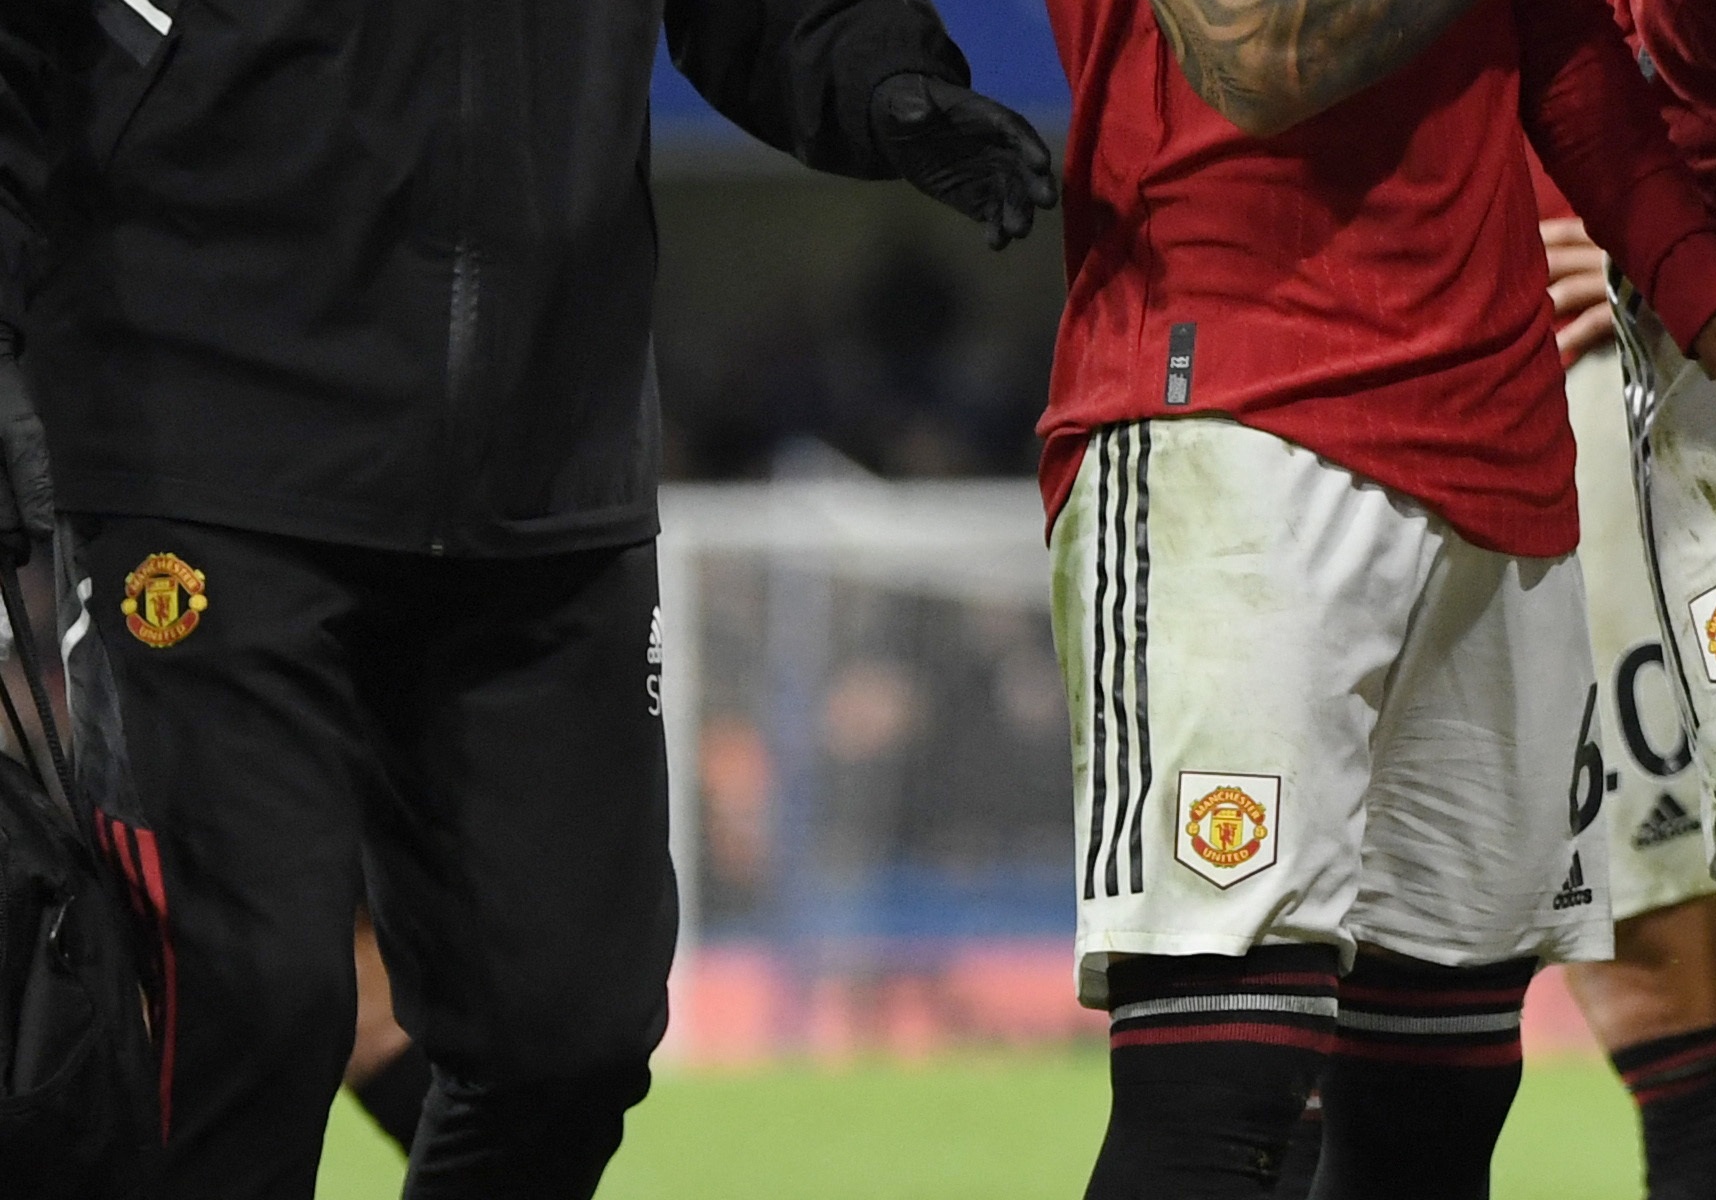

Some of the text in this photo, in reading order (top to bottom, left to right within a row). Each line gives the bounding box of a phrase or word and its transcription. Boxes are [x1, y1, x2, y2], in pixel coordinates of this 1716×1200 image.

[1569, 682, 1604, 836] 6
[1194, 791, 1261, 820] MANCHESTER
[1202, 848, 1249, 863] UNITED
